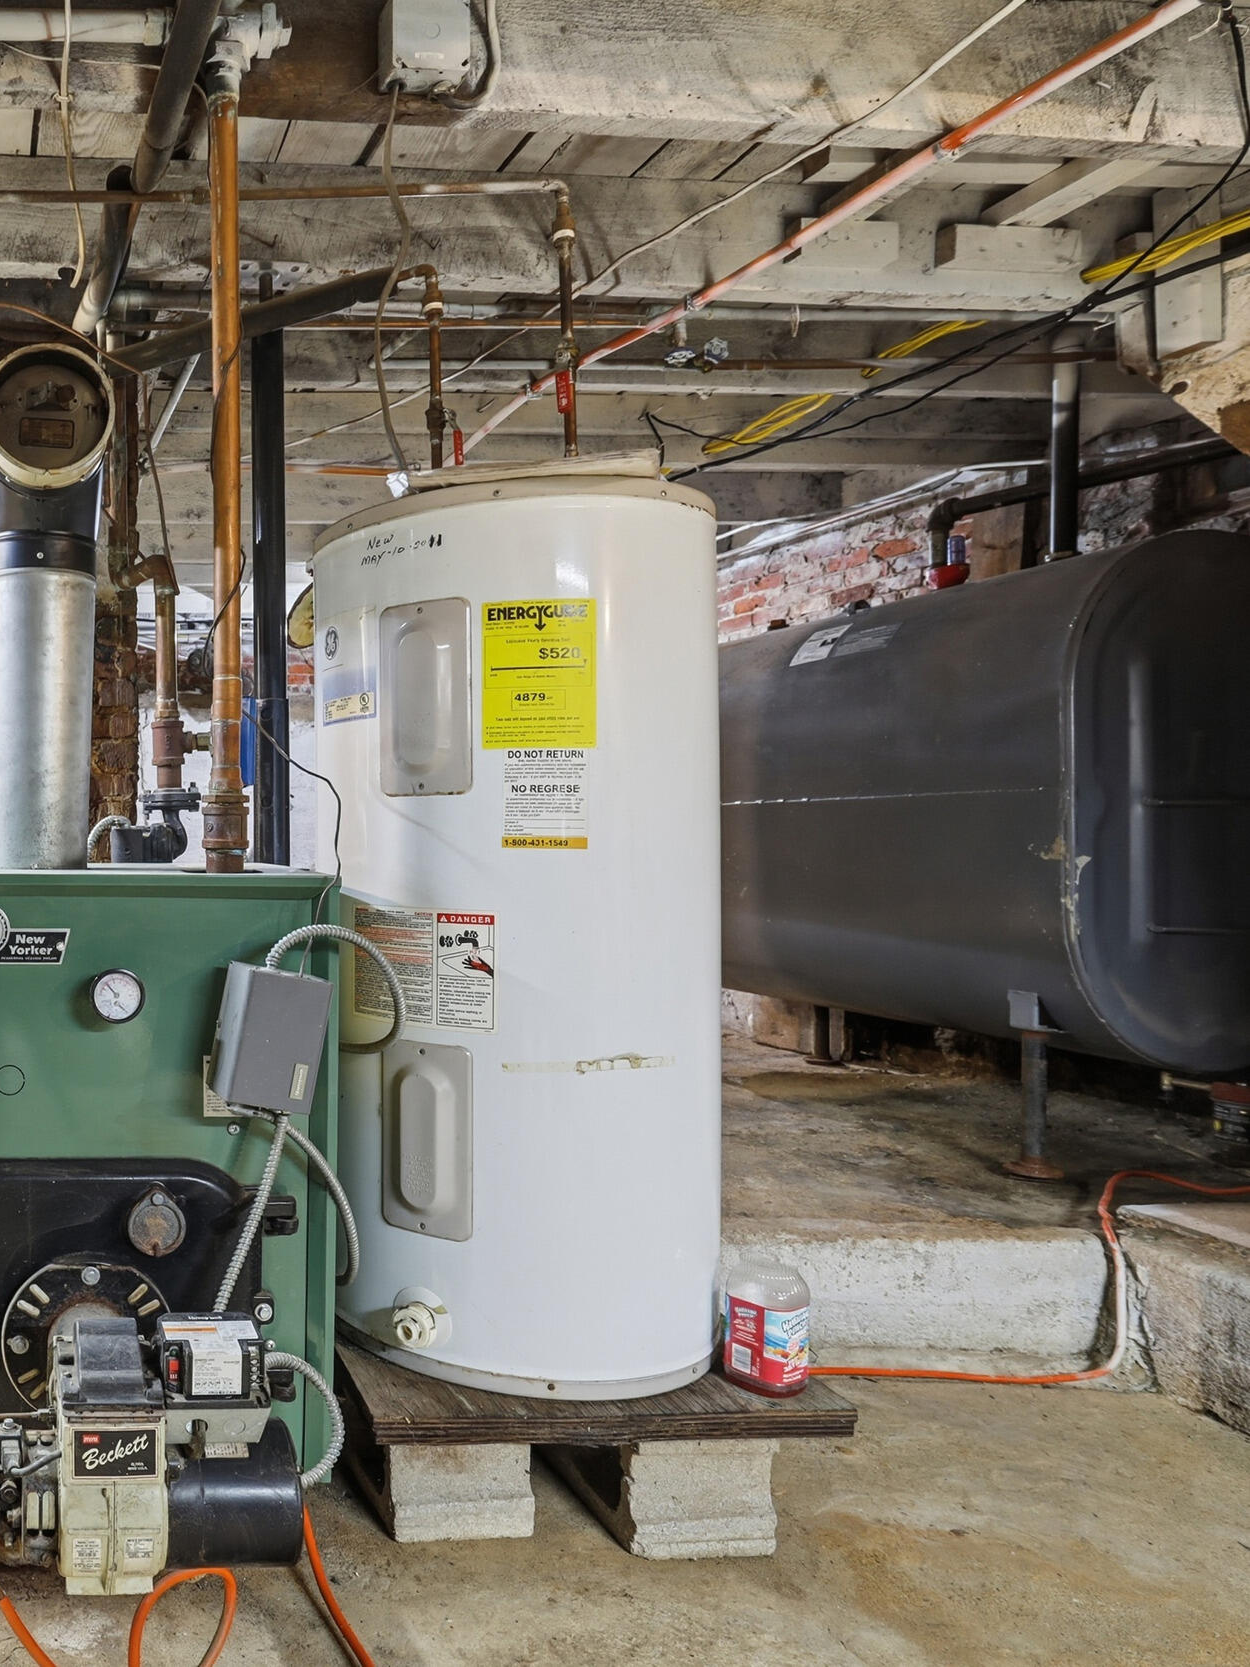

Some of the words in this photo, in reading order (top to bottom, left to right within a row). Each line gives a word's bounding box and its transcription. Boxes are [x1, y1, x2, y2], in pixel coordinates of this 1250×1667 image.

[538, 647, 581, 660] $520
[514, 692, 546, 702] 4879
[507, 750, 522, 759] DO
[524, 750, 543, 758] NOT
[546, 750, 584, 758] RETURN
[511, 785, 527, 793] NO
[529, 785, 580, 793] REGRESE
[450, 915, 491, 923] DANGER
[15, 934, 46, 944] New
[8, 945, 54, 955] Yorker
[81, 1433, 150, 1471] Beckett
